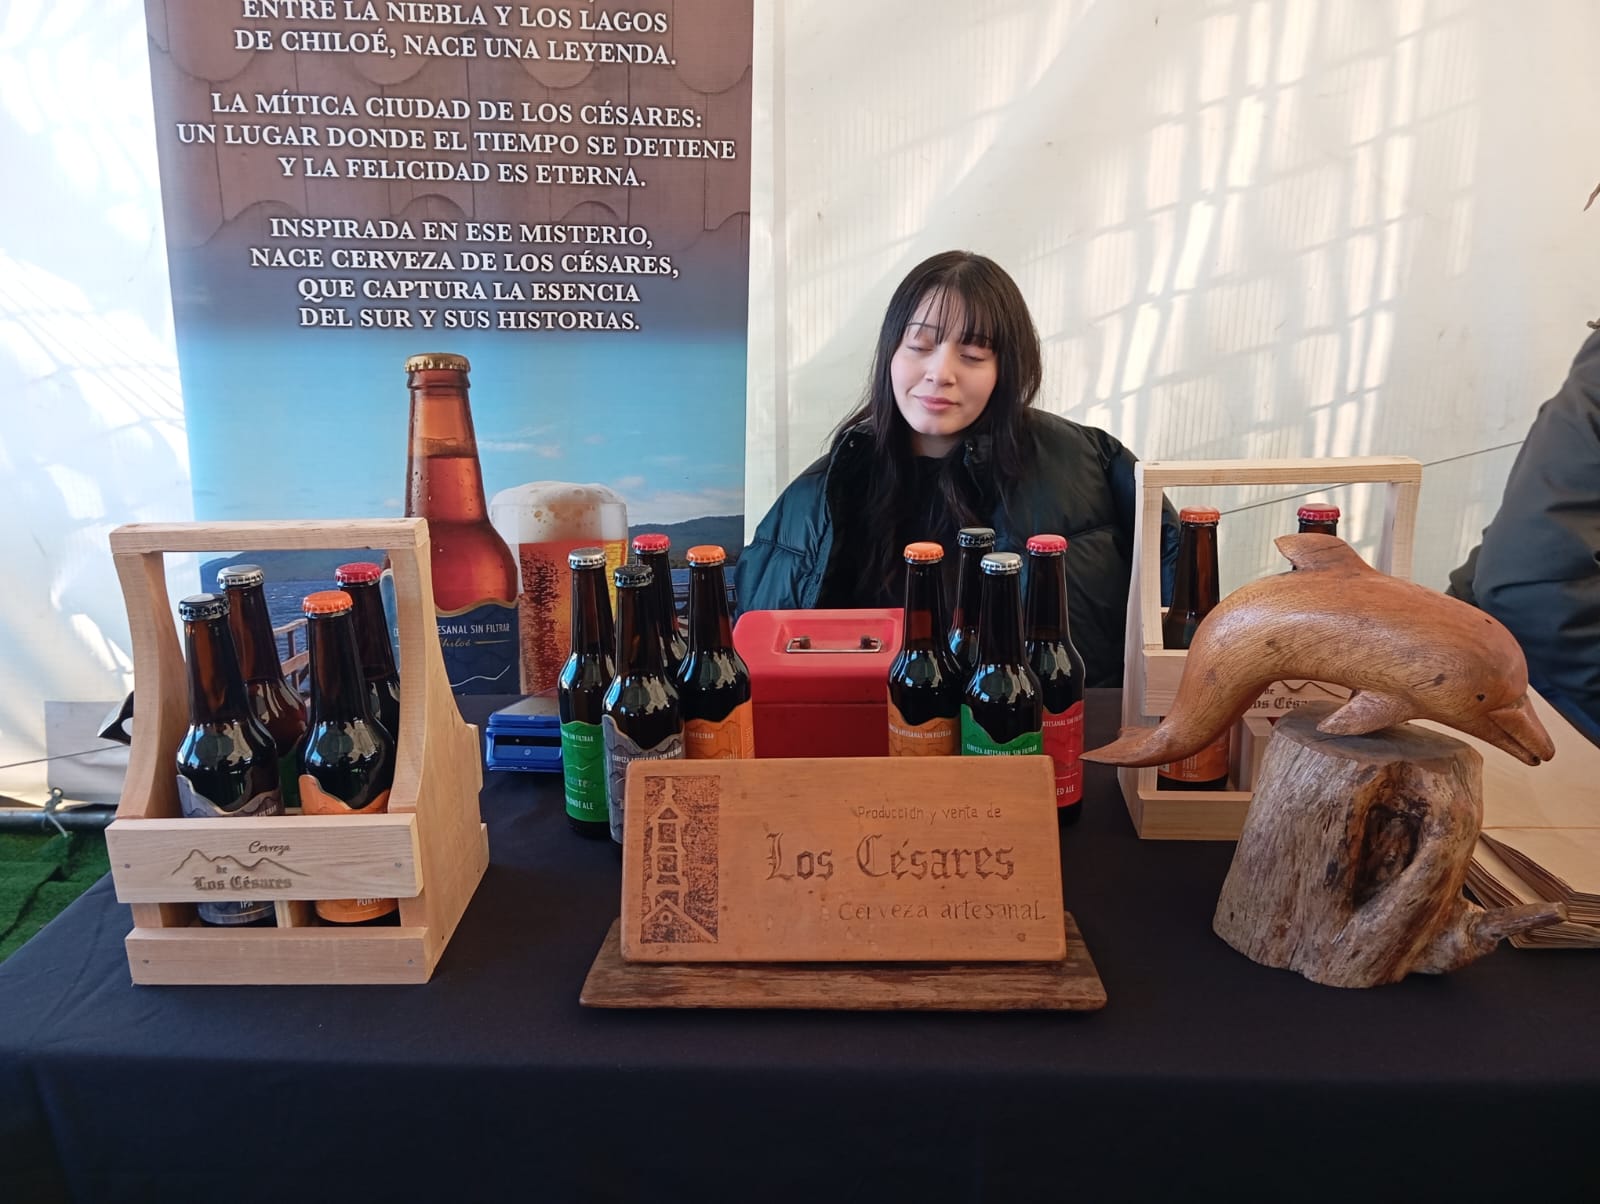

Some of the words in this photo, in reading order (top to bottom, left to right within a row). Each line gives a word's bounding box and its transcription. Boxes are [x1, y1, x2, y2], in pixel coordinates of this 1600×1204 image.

[242, 0, 337, 20] ENTRE
[343, 0, 380, 21] LA
[386, 1, 488, 26] NIEBLA
[493, 5, 513, 26] Y
[519, 6, 572, 29] LOS
[579, 10, 668, 33] LAGOS
[234, 29, 273, 50] DE
[280, 27, 396, 59] CHILOÉ,
[403, 34, 477, 57] NACE
[483, 37, 541, 60] UNA
[547, 40, 676, 65] LEYENDA.
[211, 92, 249, 113] LA
[254, 89, 359, 116] MÍTICA
[365, 97, 471, 120] CIUDAD
[477, 100, 514, 121] DE
[520, 102, 573, 124] LOS
[580, 100, 702, 128] CÉSARES:
[176, 123, 217, 144] UN
[223, 124, 321, 146] LUGAR
[325, 127, 427, 150] DONDE
[432, 130, 468, 151] EL
[473, 132, 579, 154] TIEMPO
[587, 135, 617, 156] SE
[623, 137, 736, 159] DETIENE
[277, 157, 297, 177] Y
[303, 157, 340, 178] LA
[345, 158, 490, 182] FELICIDAD
[496, 163, 529, 183] ES
[535, 164, 646, 187] ETERNA.
[269, 218, 417, 240] INSPIRADA
[422, 221, 458, 241] EN
[465, 222, 513, 242] ESE
[519, 224, 653, 250] MISTERIO,
[250, 247, 324, 268] NACE
[331, 249, 456, 270] CERVEZA
[460, 252, 497, 271] DE
[503, 253, 554, 272] LOS
[561, 249, 679, 279] CÉSARES,
[298, 278, 356, 303] QUE
[362, 279, 488, 300] CAPTURA
[492, 282, 526, 301] LA
[531, 283, 641, 302] ESENCIA
[299, 307, 353, 327] DEL
[359, 308, 414, 328] SUR
[418, 309, 437, 328] Y
[444, 309, 490, 329] SUS
[496, 311, 640, 330] HISTORIAS.
[437, 624, 469, 635] ESANAL
[470, 624, 484, 634] SIN
[486, 623, 510, 633] FILTRAR
[1056, 788, 1065, 797] ED
[1065, 784, 1075, 794] ALE
[582, 801, 594, 811] ALE
[930, 811, 937, 825] y
[942, 804, 979, 820] venta
[987, 803, 1003, 819] de
[248, 840, 291, 857] Cerveza
[766, 832, 834, 881] Los
[856, 833, 1014, 881] Césares
[215, 864, 228, 875] de
[192, 876, 226, 891] Los
[229, 875, 293, 892] Césares
[838, 902, 929, 921] Cerveza
